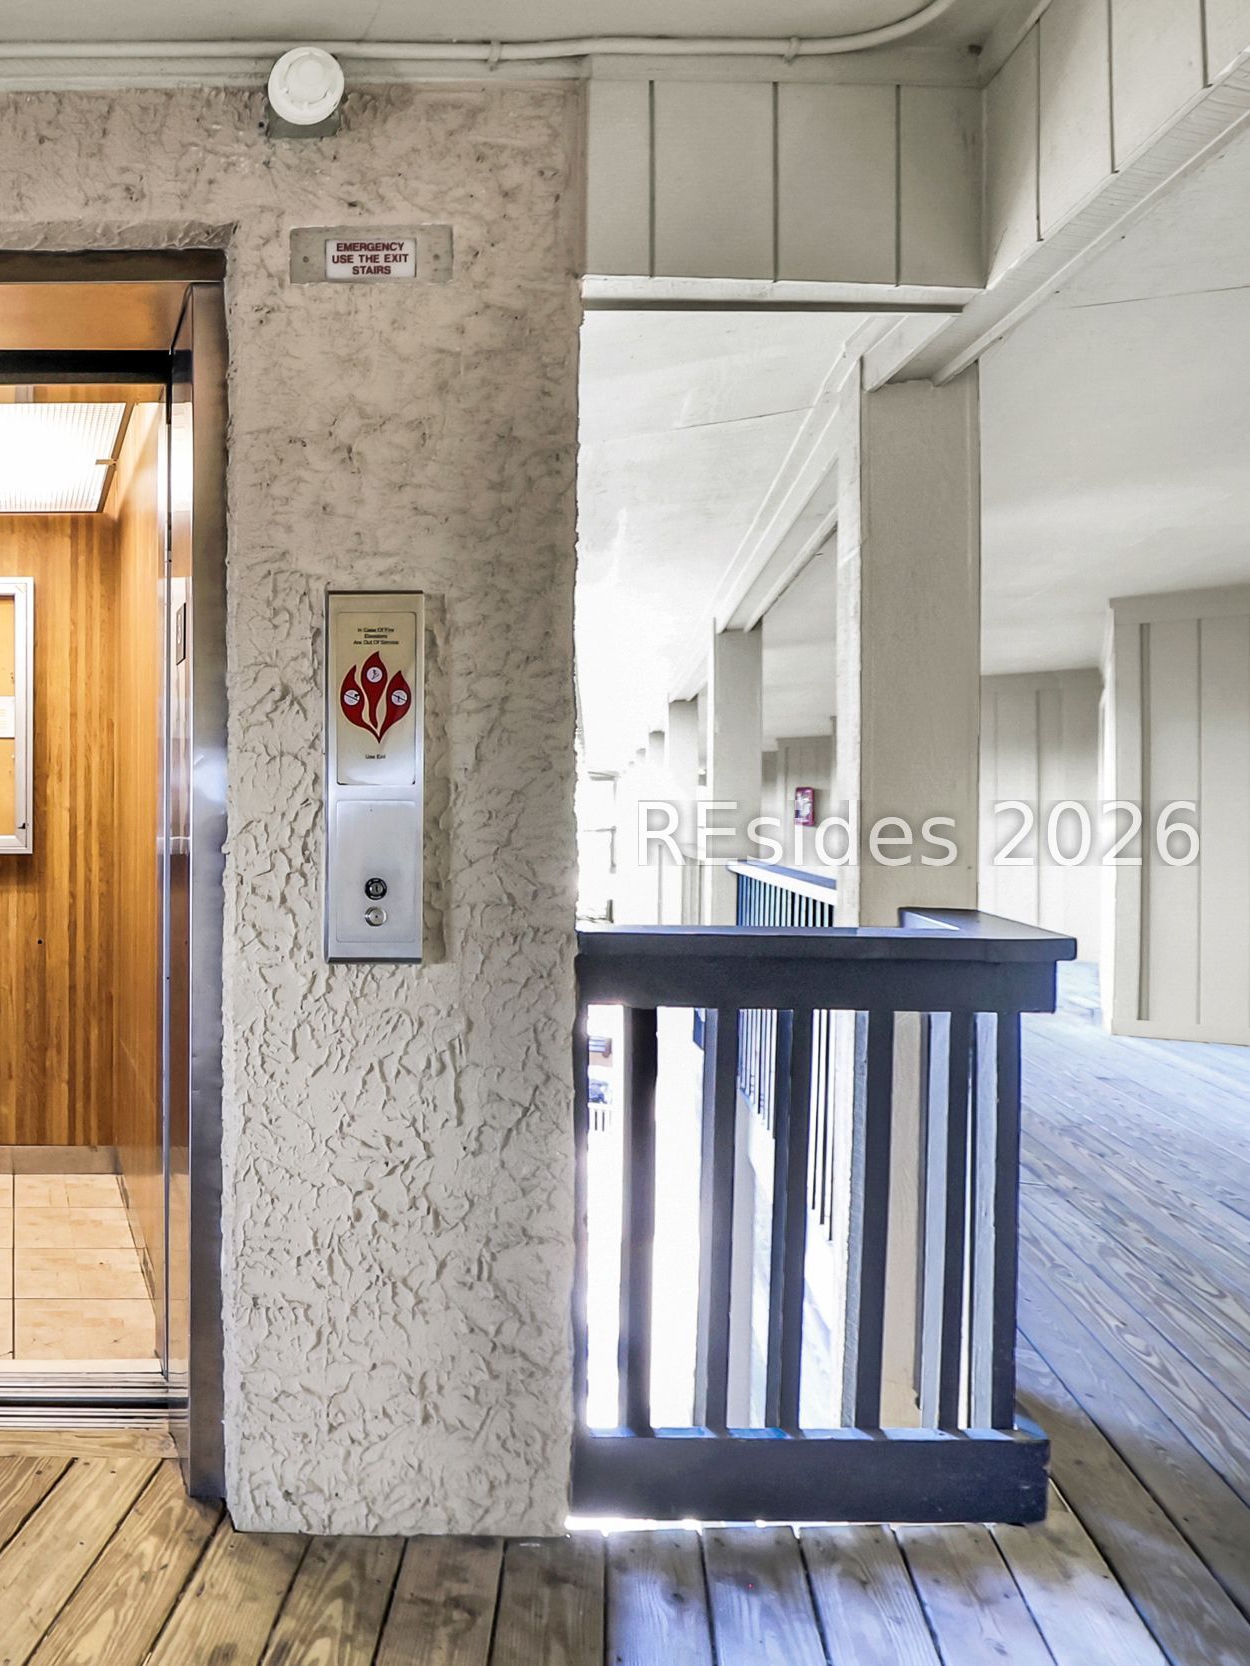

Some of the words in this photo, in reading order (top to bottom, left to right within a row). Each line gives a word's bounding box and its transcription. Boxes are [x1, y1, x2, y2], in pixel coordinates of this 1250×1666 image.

[336, 242, 405, 252] EMERGENCY
[331, 254, 354, 264] USE
[358, 254, 380, 264] THE
[383, 253, 409, 263] EXIT
[352, 265, 391, 275] STAIRS
